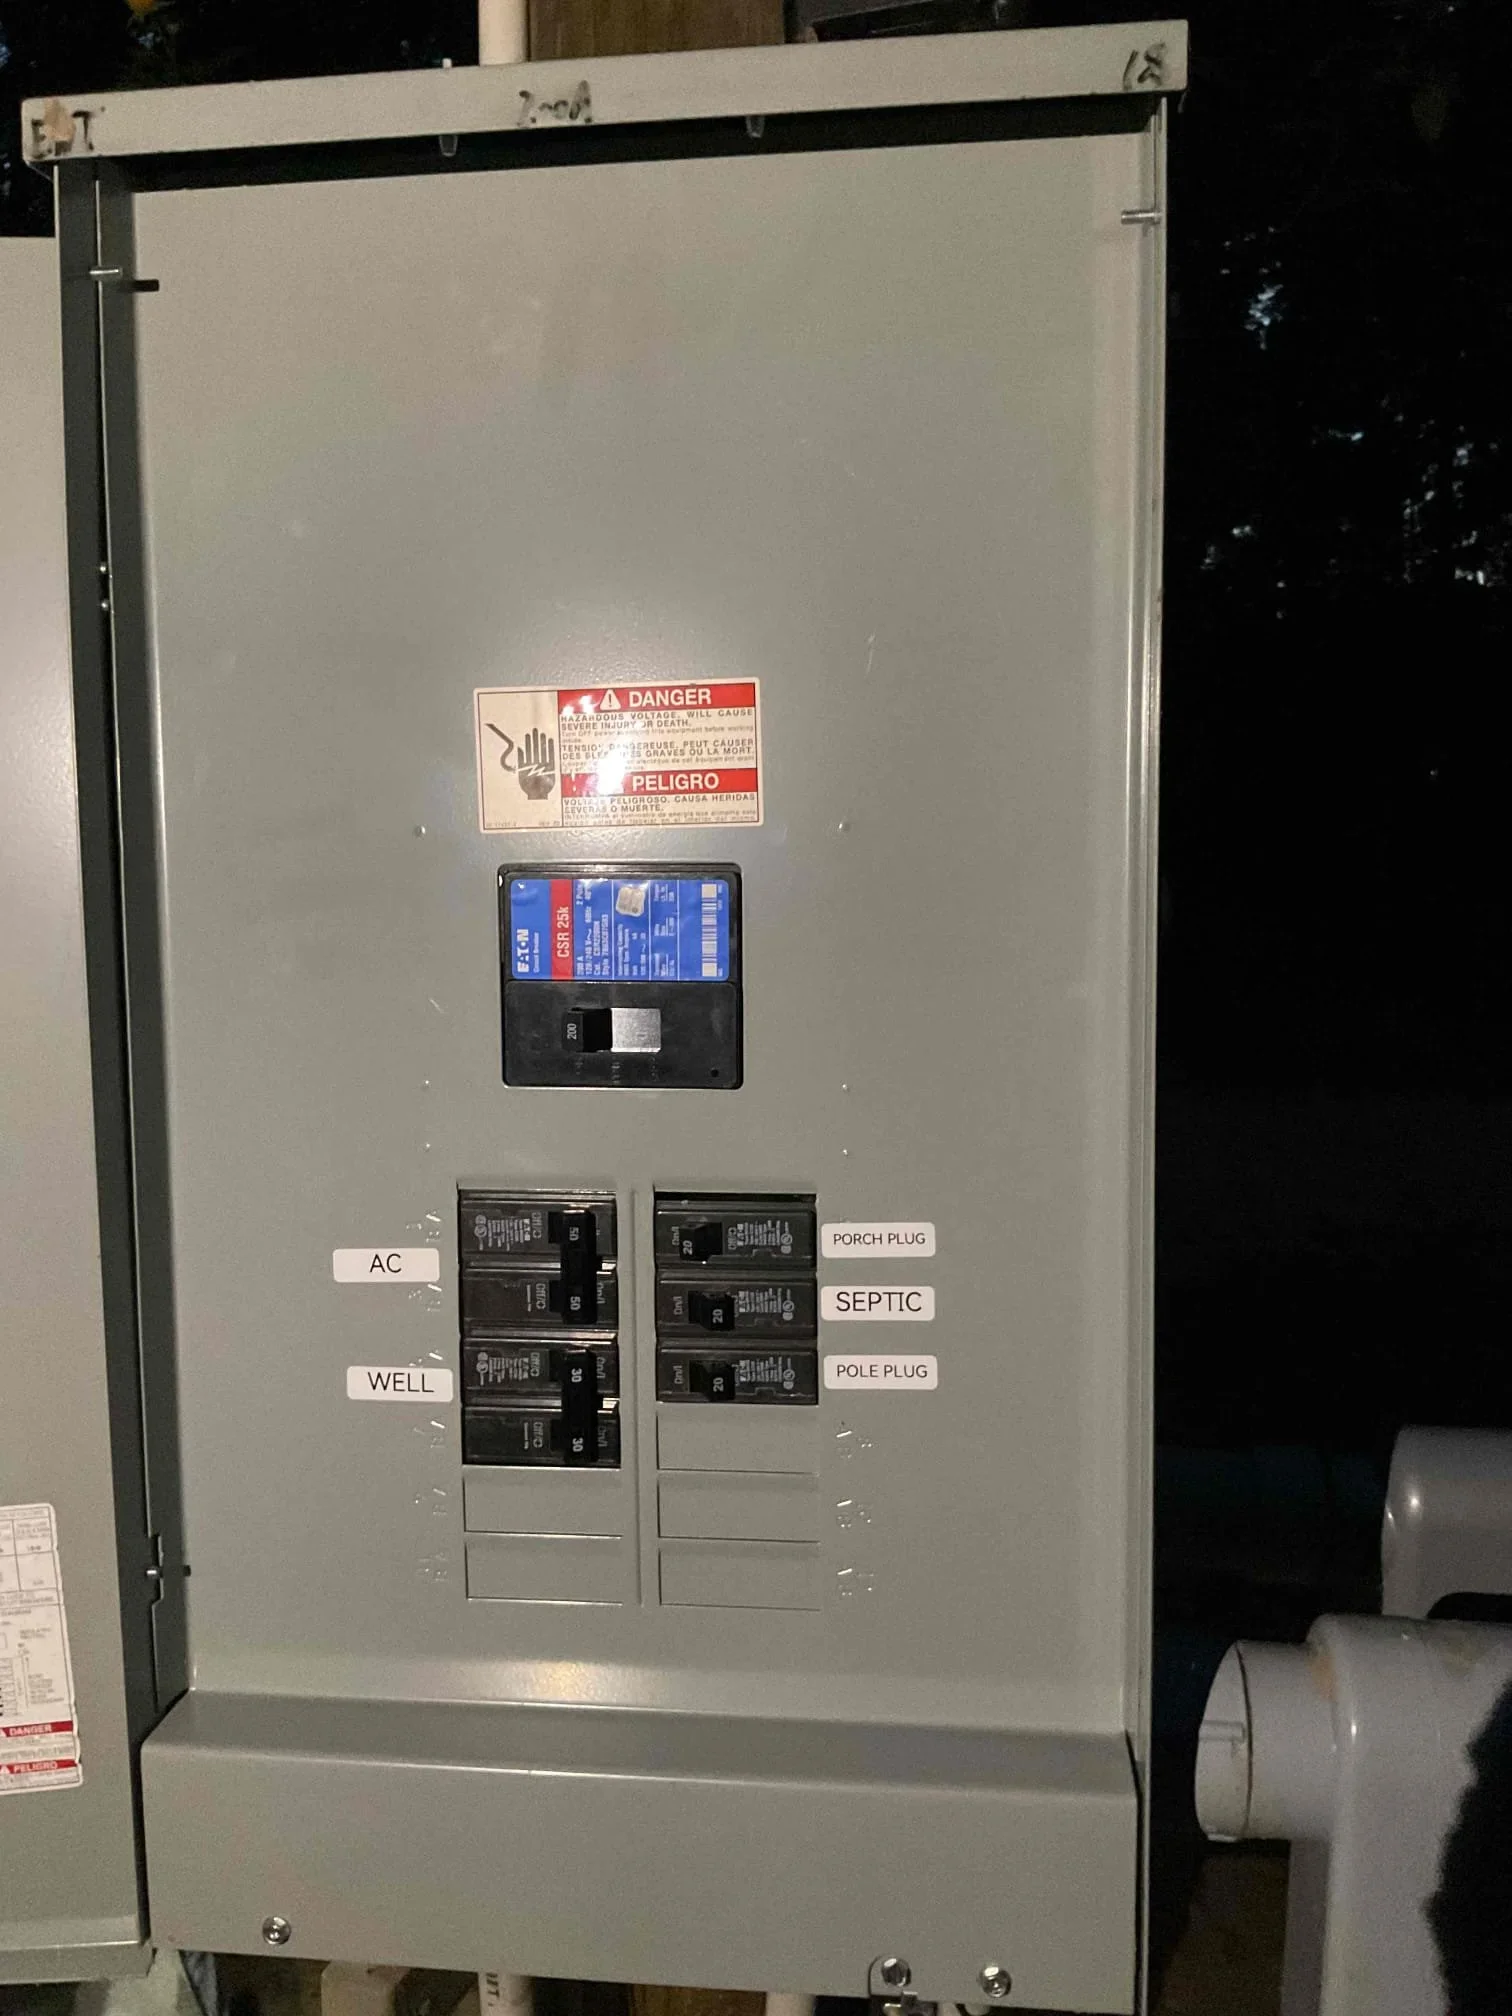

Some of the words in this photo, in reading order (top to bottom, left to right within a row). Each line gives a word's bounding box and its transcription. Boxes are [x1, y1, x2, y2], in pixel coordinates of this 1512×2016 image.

[628, 688, 712, 708] DANGER
[561, 713, 625, 723] HAZARDOUS
[686, 710, 712, 719] WILL
[718, 708, 753, 718] CAUSE
[561, 721, 598, 731] SEVERE
[601, 720, 637, 730] INJURY
[656, 719, 692, 729] DEATH.
[683, 740, 707, 748] PEUT
[713, 738, 754, 747] CAUSER
[562, 752, 581, 761] DES
[646, 749, 685, 757] GRAVES
[689, 748, 703, 756] OU
[707, 748, 719, 756] LA
[723, 746, 755, 755] MORT.
[632, 773, 719, 792] PELIGRO
[674, 795, 707, 803] CAUSA
[712, 793, 755, 802] HERIDAS
[611, 805, 618, 813] O
[621, 804, 664, 813] MUERTE.
[556, 906, 570, 929] 25k
[517, 929, 529, 973] EATON
[556, 932, 571, 958] CSR
[567, 1023, 577, 1040] 200
[569, 1226, 580, 1241] 50
[833, 1233, 883, 1246] PORCH
[888, 1232, 926, 1245] PLUG
[683, 1240, 693, 1255] 20
[369, 1253, 402, 1273] AC
[570, 1296, 581, 1311] 50
[836, 1291, 922, 1312] SEPTIC
[712, 1308, 723, 1324] 20
[571, 1368, 582, 1383] 30
[836, 1364, 880, 1378] POLE
[883, 1364, 928, 1378] PLUG
[367, 1371, 434, 1392] WELL
[713, 1377, 724, 1392] 20
[572, 1437, 584, 1453] 30
[9, 1724, 52, 1736] DANGER
[13, 1761, 58, 1773] PELIGRO
